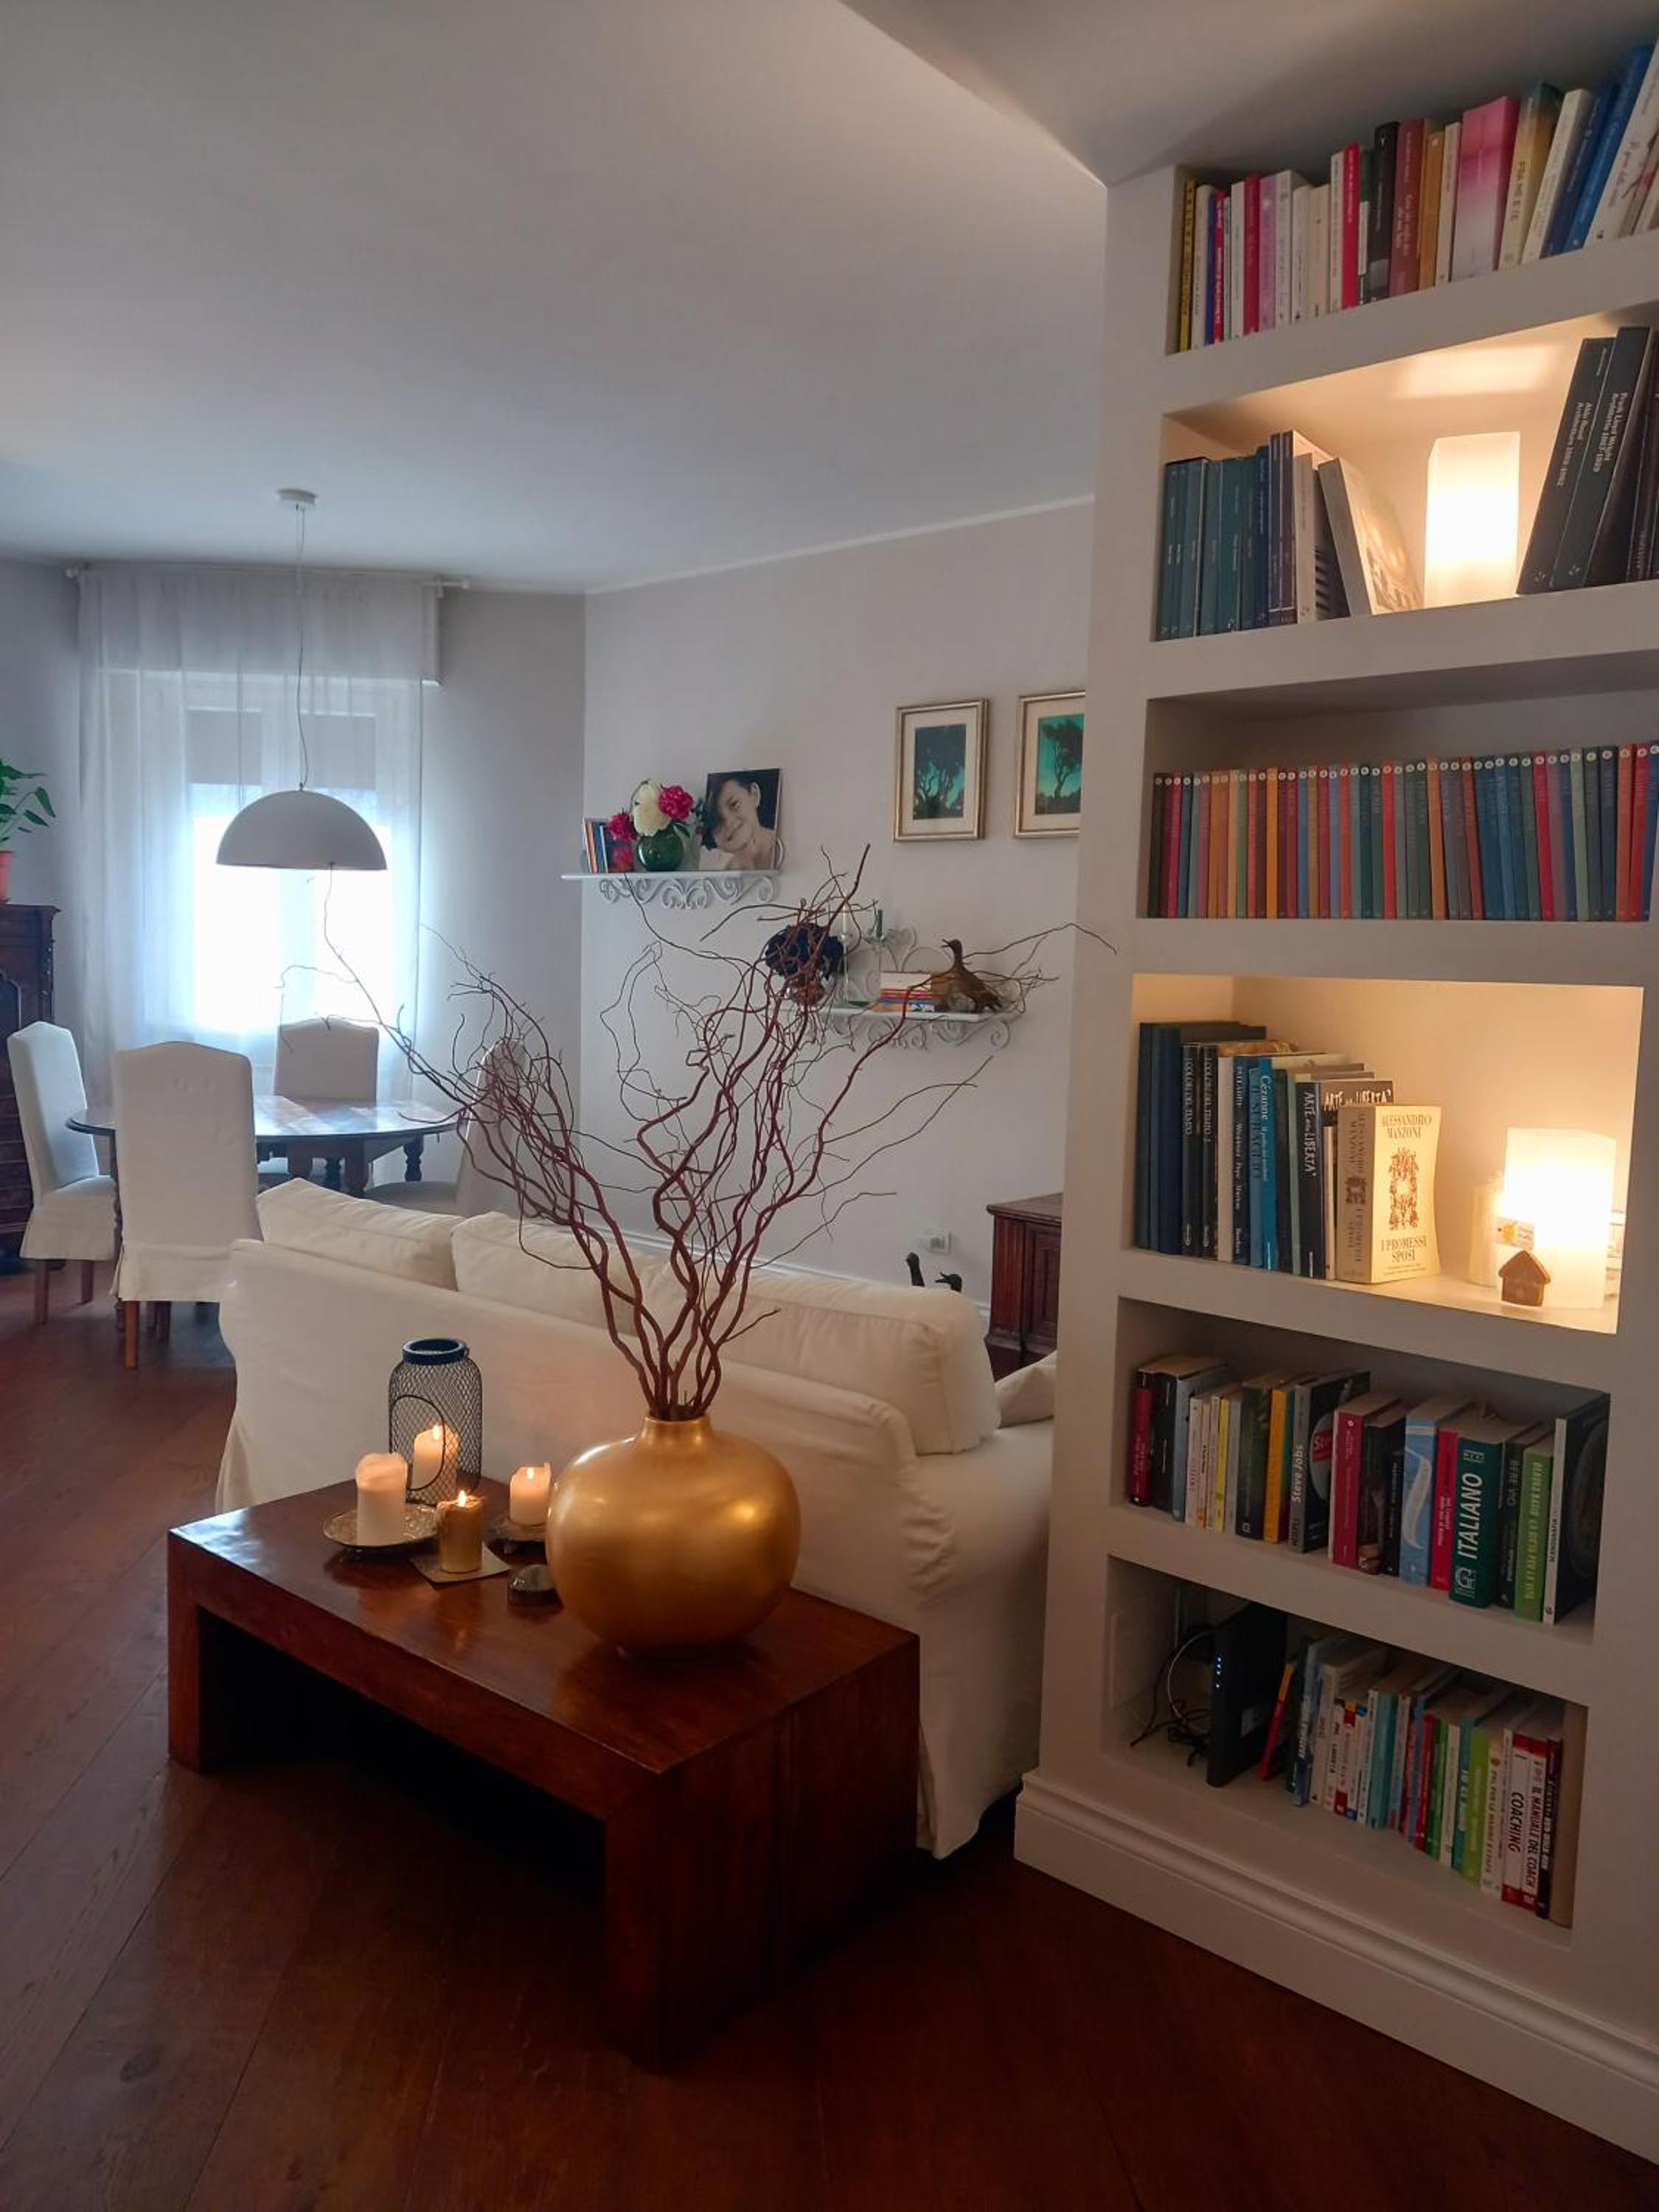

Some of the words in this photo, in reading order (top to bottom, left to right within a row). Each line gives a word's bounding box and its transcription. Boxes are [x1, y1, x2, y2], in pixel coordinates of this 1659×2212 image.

[1262, 1075, 1271, 1120] Cézanne
[1304, 1092, 1315, 1116] ARTE
[1324, 1091, 1343, 1111] ARTE
[1381, 1114, 1433, 1127] ALESSANDRO
[1387, 1126, 1422, 1139] MANZONI
[1385, 1235, 1427, 1251] PROMESSI
[1391, 1249, 1415, 1263] SPOSI
[1292, 1444, 1304, 1470] Jobs
[1292, 1472, 1303, 1504] Steve
[1458, 1472, 1484, 1560] ITALIANO
[1508, 1792, 1524, 1853] COACHING
[1528, 1796, 1541, 1838] MANUALE
[1527, 1840, 1539, 1854] DEL
[1526, 1857, 1537, 1888] COACH
